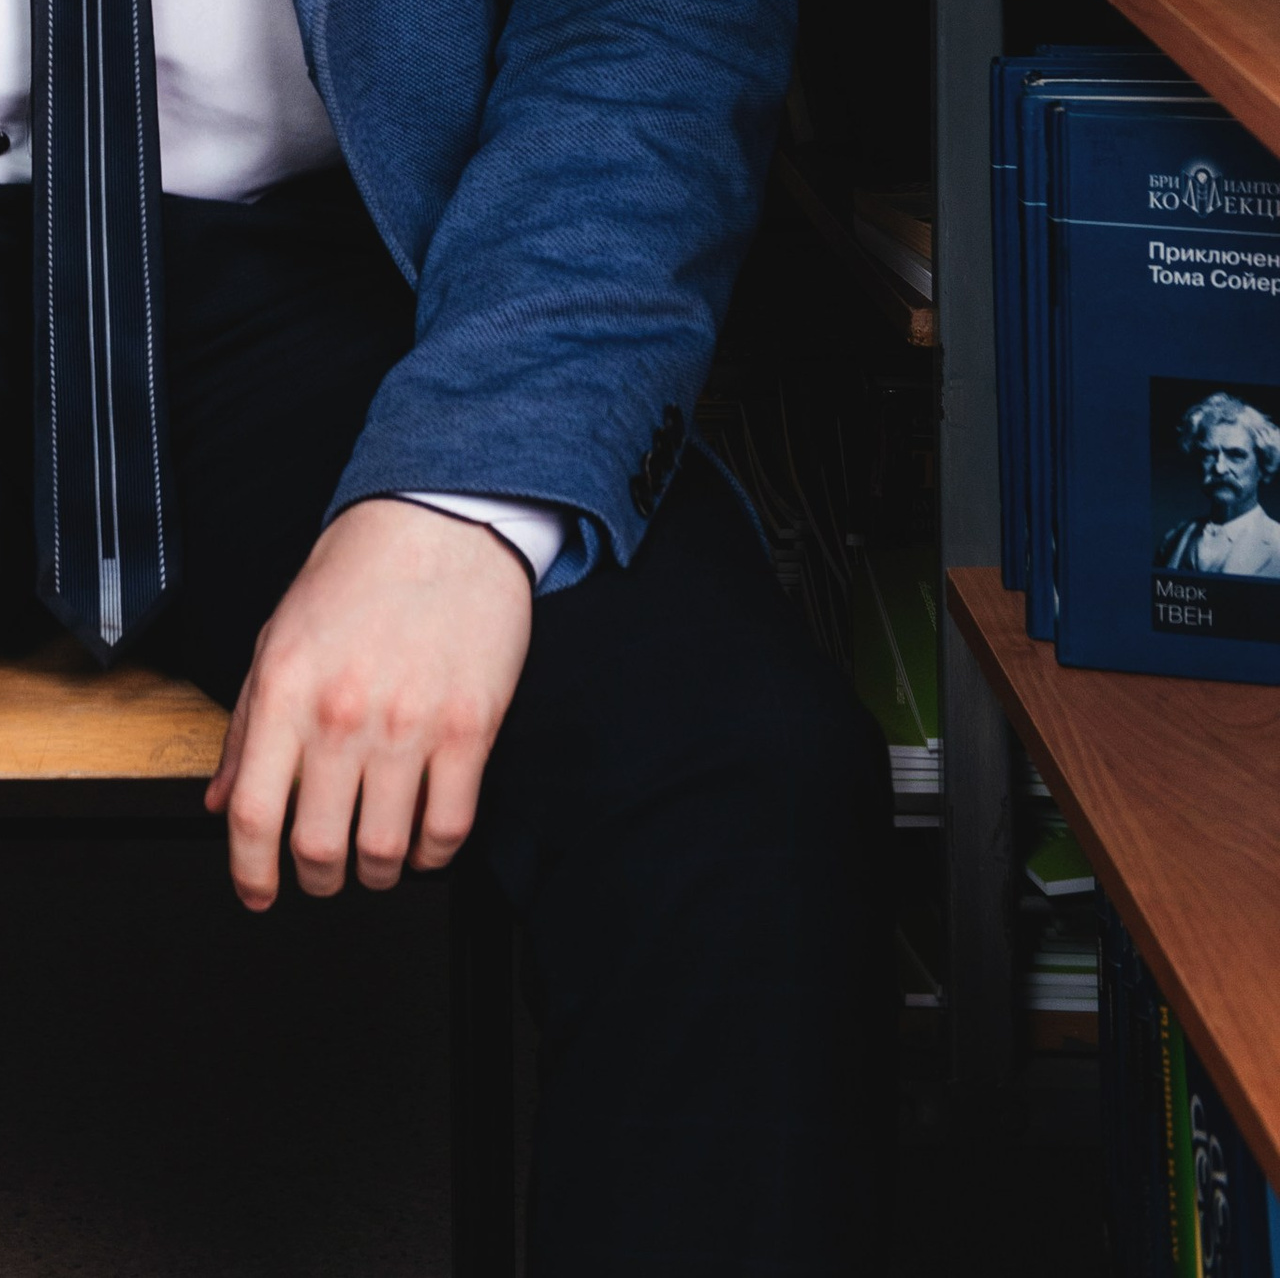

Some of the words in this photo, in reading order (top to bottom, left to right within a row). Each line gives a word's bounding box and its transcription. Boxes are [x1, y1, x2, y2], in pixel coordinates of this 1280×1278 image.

[1148, 265, 1205, 287] Тома
[1155, 579, 1208, 602] Марк
[1154, 602, 1213, 627] ТВЕН
